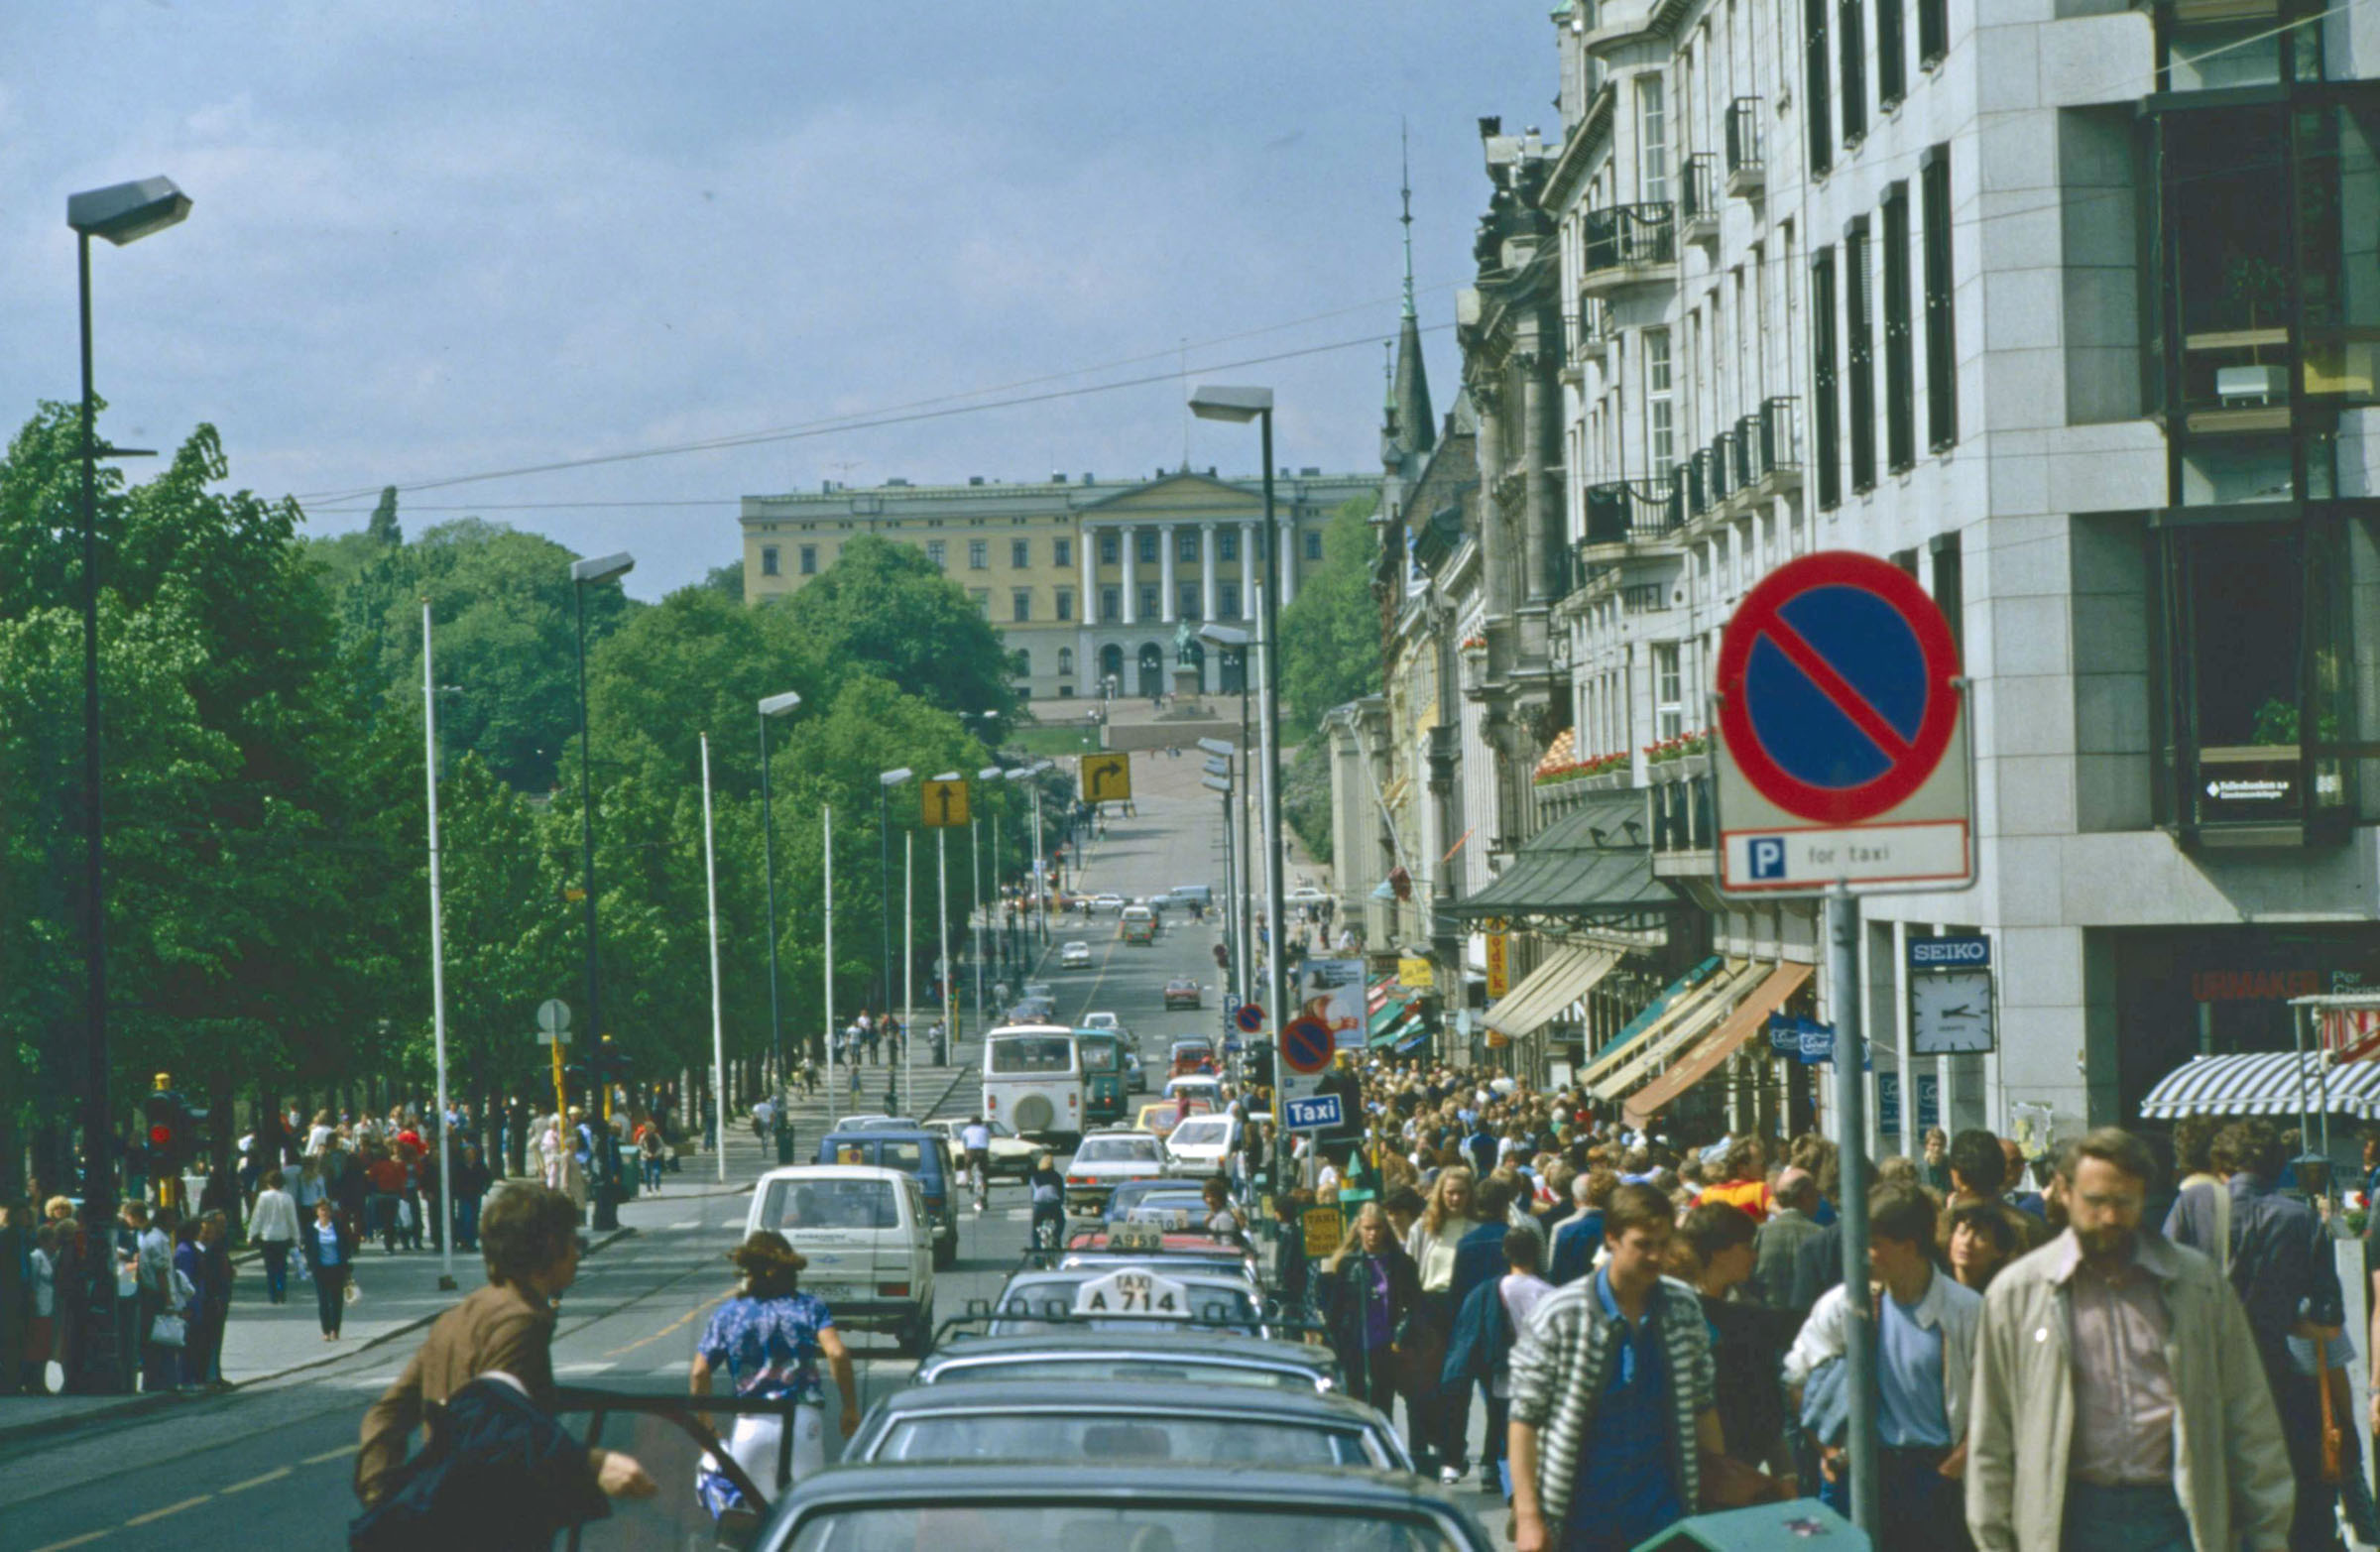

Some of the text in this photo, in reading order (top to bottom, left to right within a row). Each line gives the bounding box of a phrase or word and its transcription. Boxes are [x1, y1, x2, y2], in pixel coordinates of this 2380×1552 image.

[1756, 842, 1890, 877] P for taxi
[1914, 942, 1985, 961] SEIKO
[2331, 970, 2362, 984] Per
[1290, 1100, 1336, 1123] Taxi
[1116, 1274, 1151, 1288] TAXI
[1121, 1291, 1176, 1312] 714
